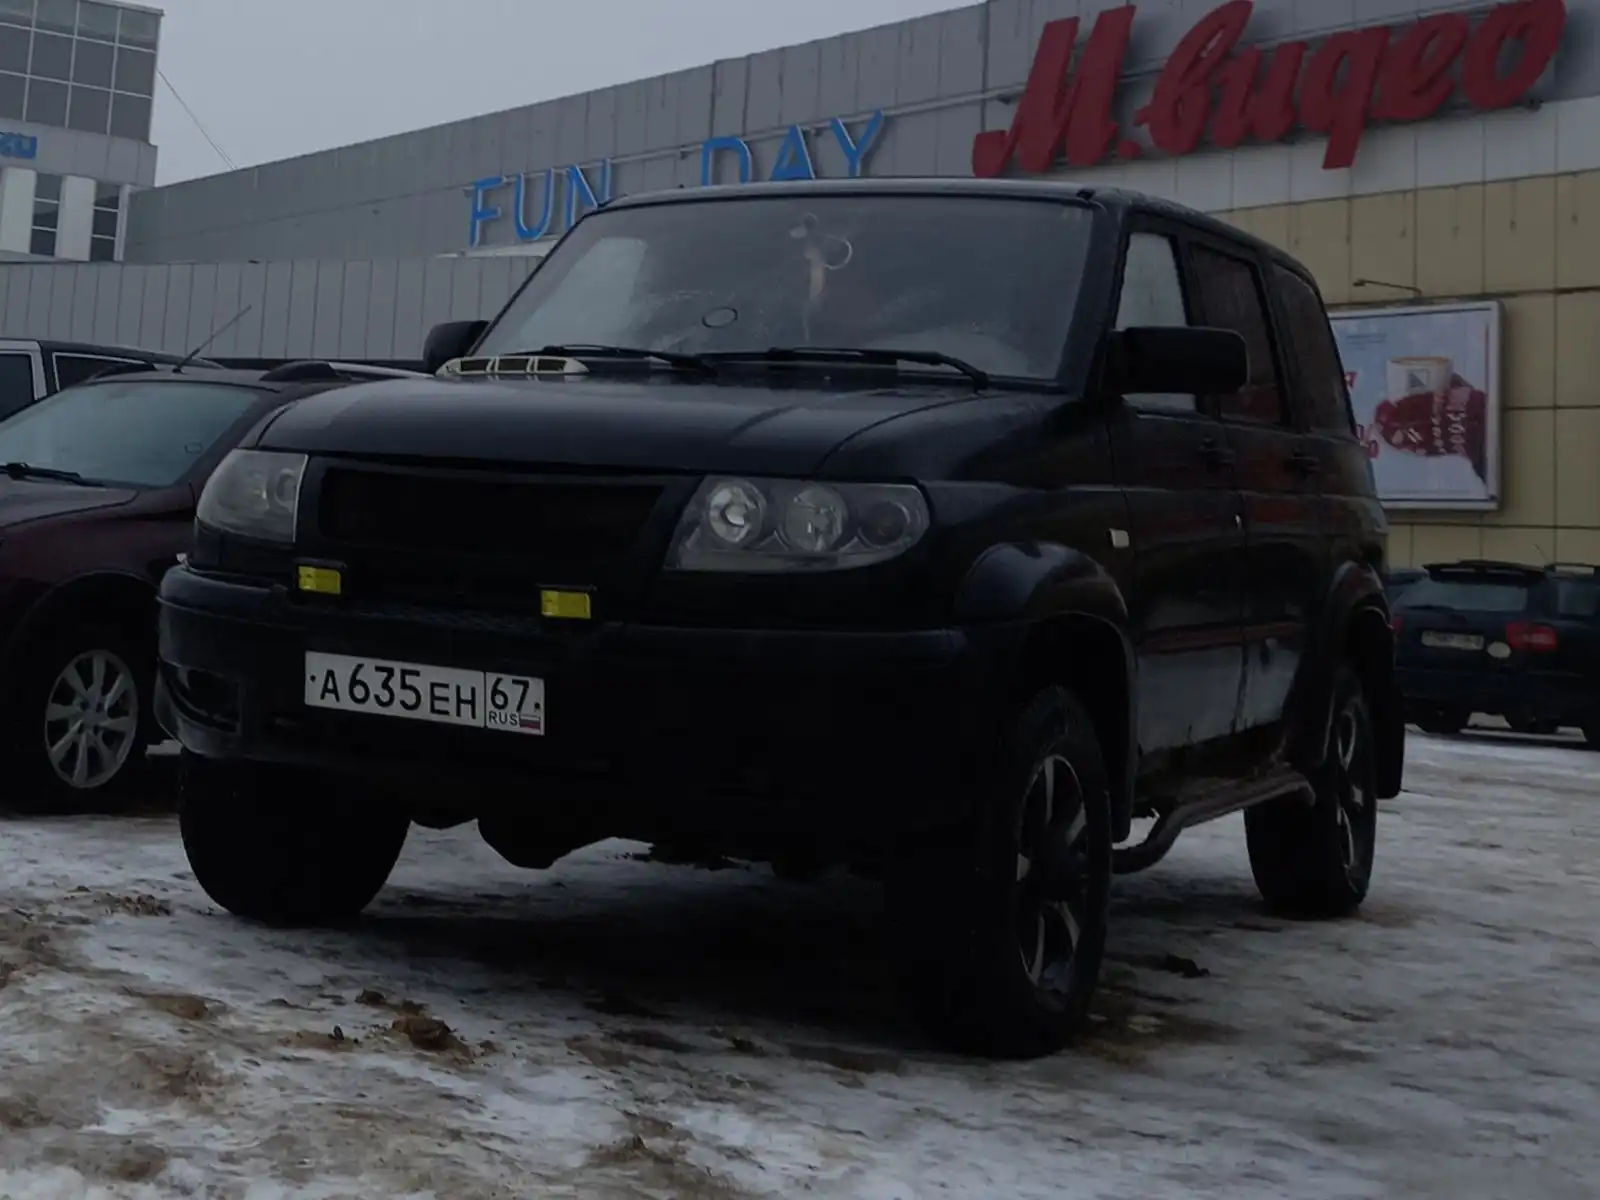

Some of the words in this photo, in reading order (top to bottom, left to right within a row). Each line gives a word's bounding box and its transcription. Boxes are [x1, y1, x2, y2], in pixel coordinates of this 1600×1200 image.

[971, 0, 1567, 177] М.видео
[469, 157, 612, 248] FUN
[702, 108, 885, 187] DAY
[488, 710, 520, 726] RUS
[490, 677, 530, 713] 67
